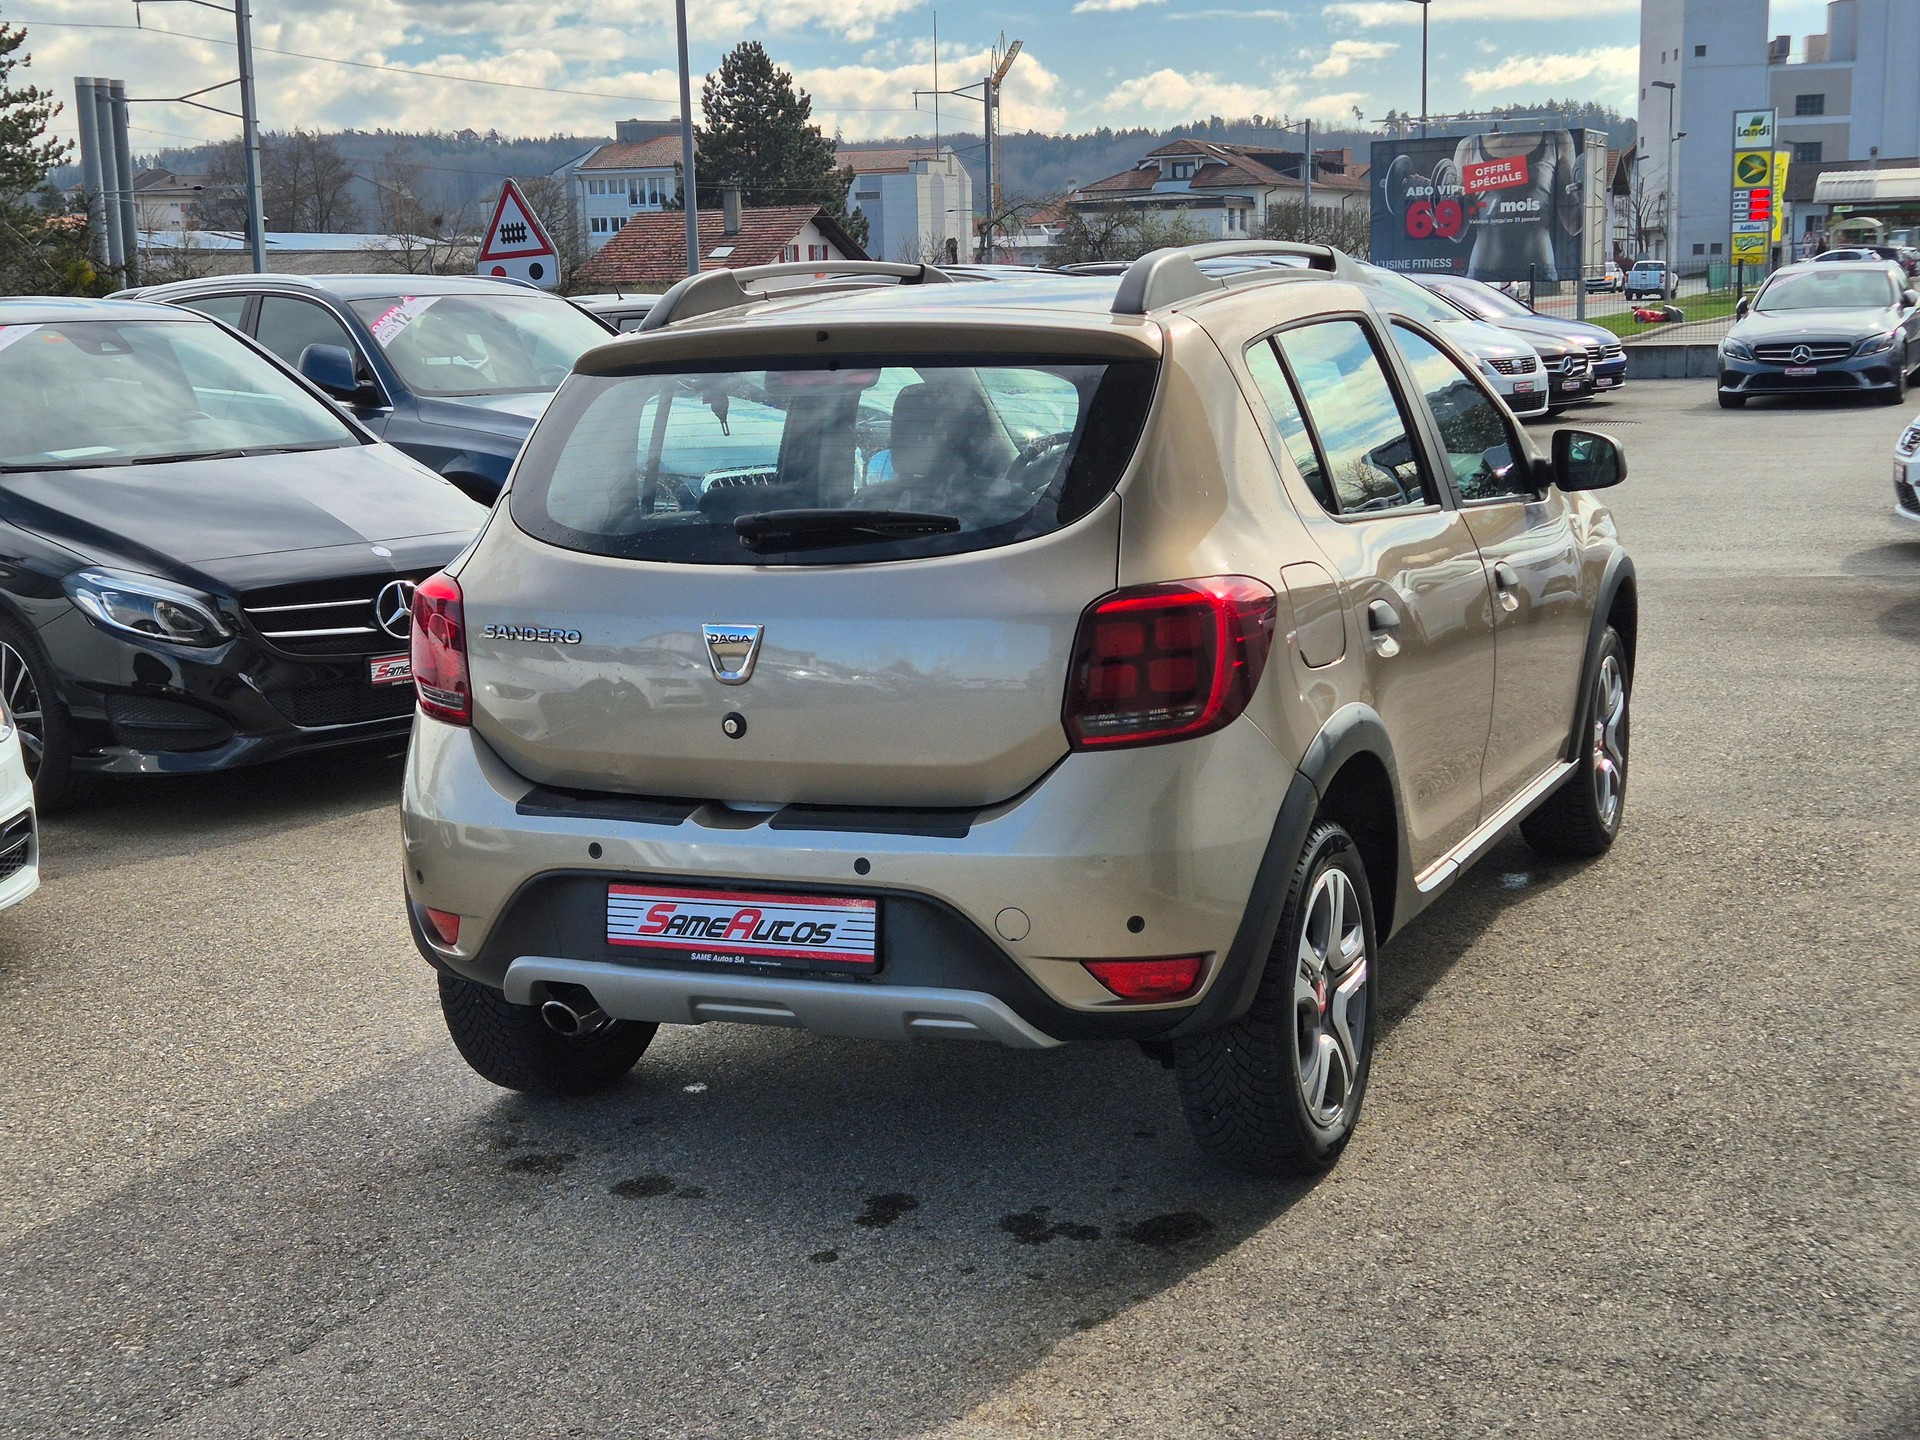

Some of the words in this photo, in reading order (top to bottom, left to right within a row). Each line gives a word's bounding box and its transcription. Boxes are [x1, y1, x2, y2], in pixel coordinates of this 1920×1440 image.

[1737, 125, 1770, 137] Landi
[1475, 162, 1511, 176] OFFRE
[1470, 171, 1522, 188] SPÉCIALE
[1406, 186, 1433, 196] ABO
[1500, 198, 1540, 212] mois
[1413, 258, 1451, 269] FITNESS
[392, 312, 413, 326] 12
[483, 624, 582, 645] SANDERO
[710, 634, 751, 643] DACIA
[691, 952, 711, 961] SAME
[712, 954, 733, 963] Autos
[734, 955, 745, 964] SA
